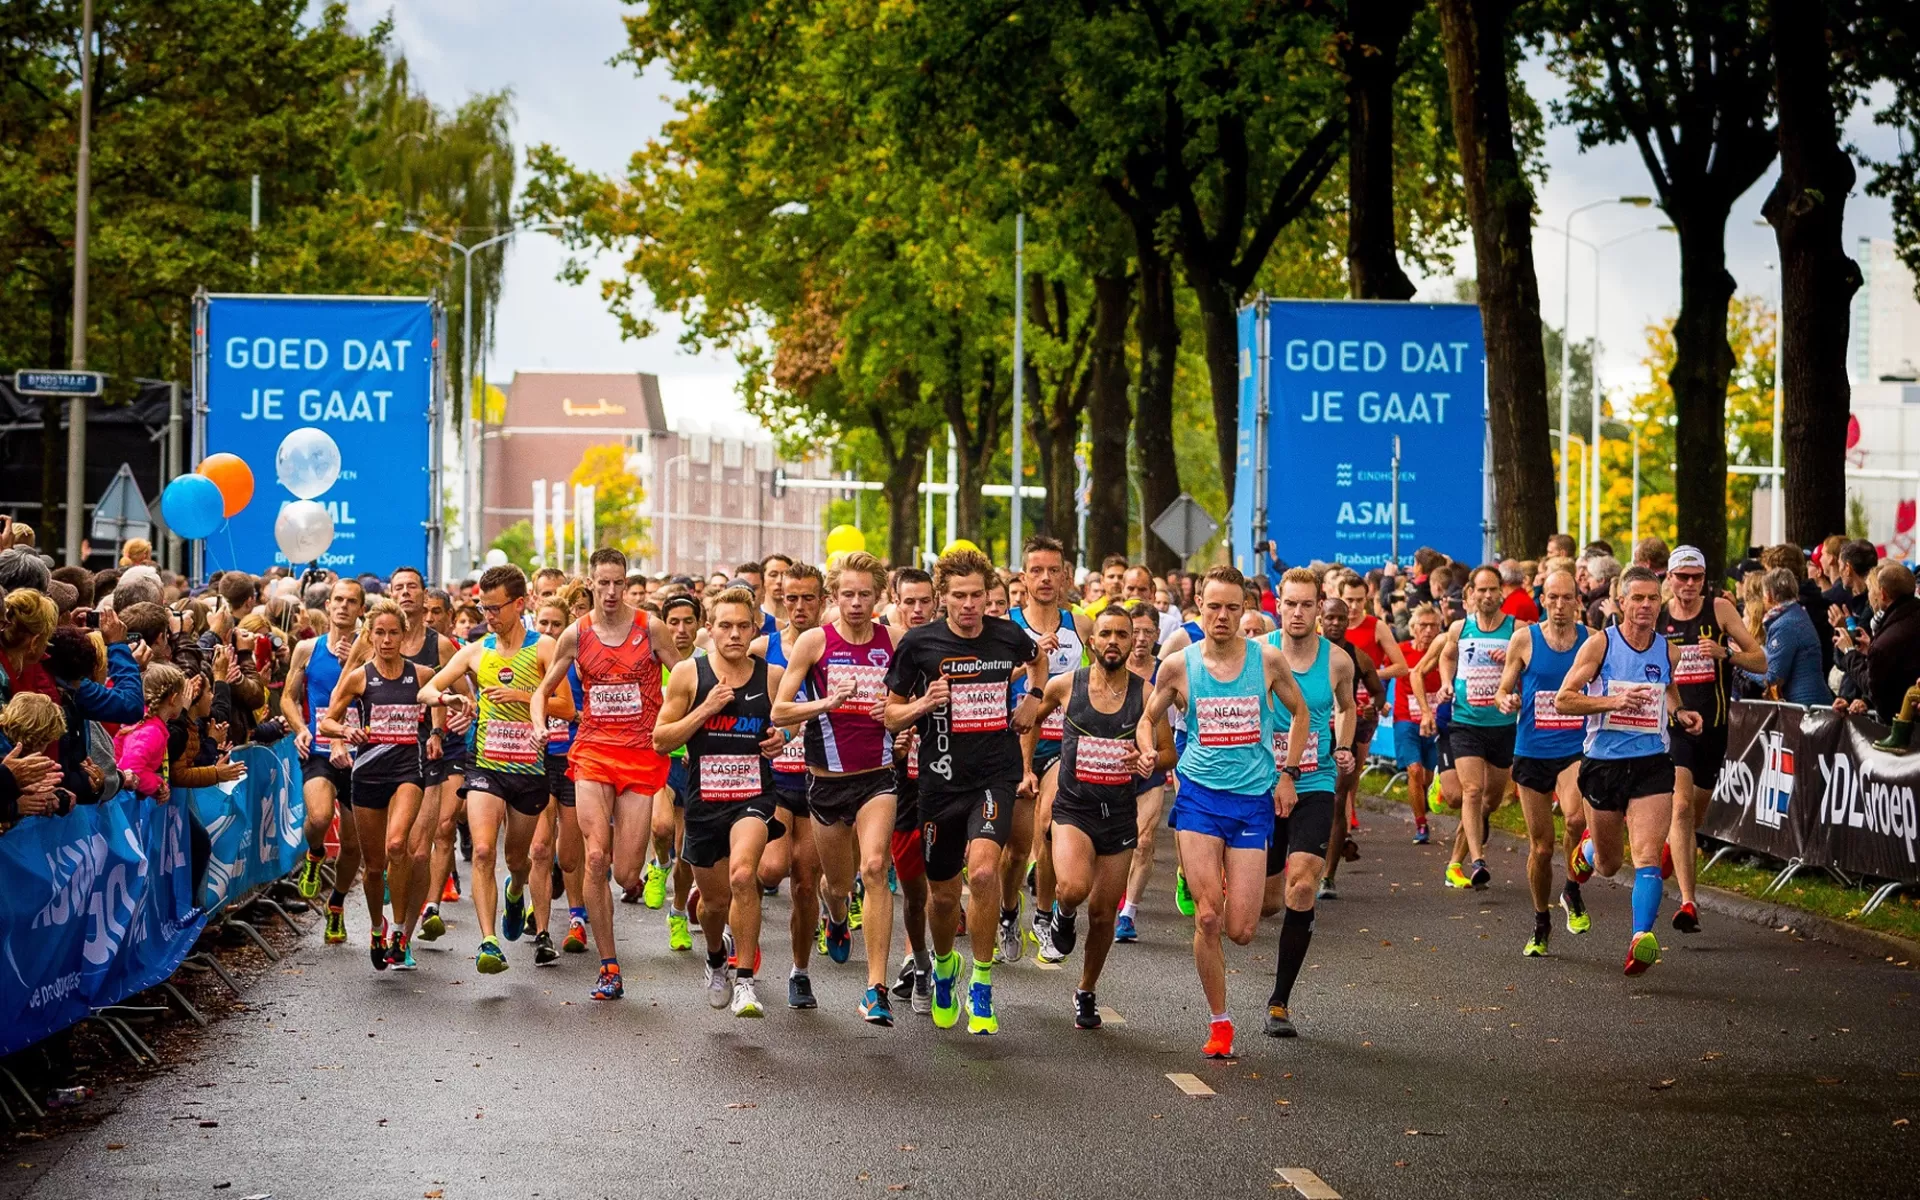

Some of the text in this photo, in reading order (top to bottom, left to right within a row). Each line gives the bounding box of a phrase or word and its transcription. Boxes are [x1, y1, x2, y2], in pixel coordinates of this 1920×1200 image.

[227, 337, 412, 371] GOED DAT
[1286, 339, 1468, 373] GOED DAT
[241, 388, 393, 422] JE GAAT
[1301, 391, 1451, 423] JE GAAT
[1336, 502, 1415, 525] ASML
[595, 692, 633, 702] RIEKELE
[967, 692, 996, 703] MARK
[1214, 707, 1243, 717] NEAL
[497, 728, 526, 739] FREEK
[711, 763, 750, 775] CASPER
